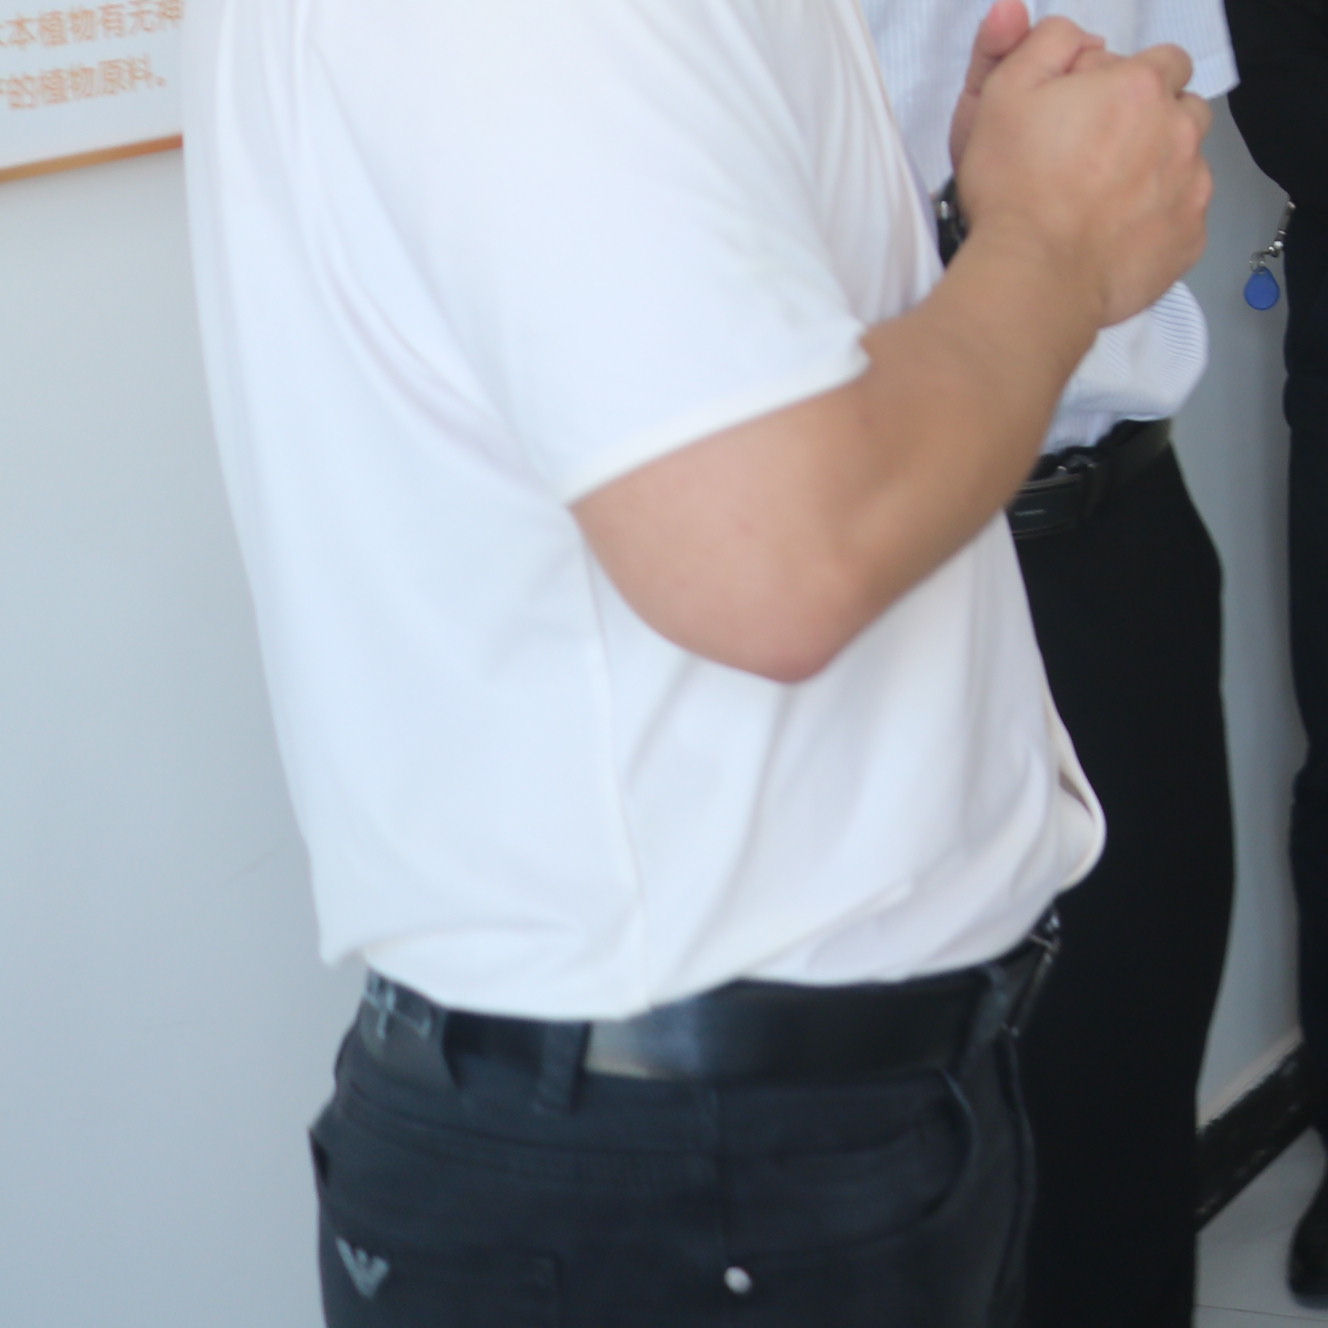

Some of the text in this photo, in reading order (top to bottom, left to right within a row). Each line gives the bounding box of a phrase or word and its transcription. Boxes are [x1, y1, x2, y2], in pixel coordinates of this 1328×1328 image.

[0, 54, 166, 110] 的植物原料。
